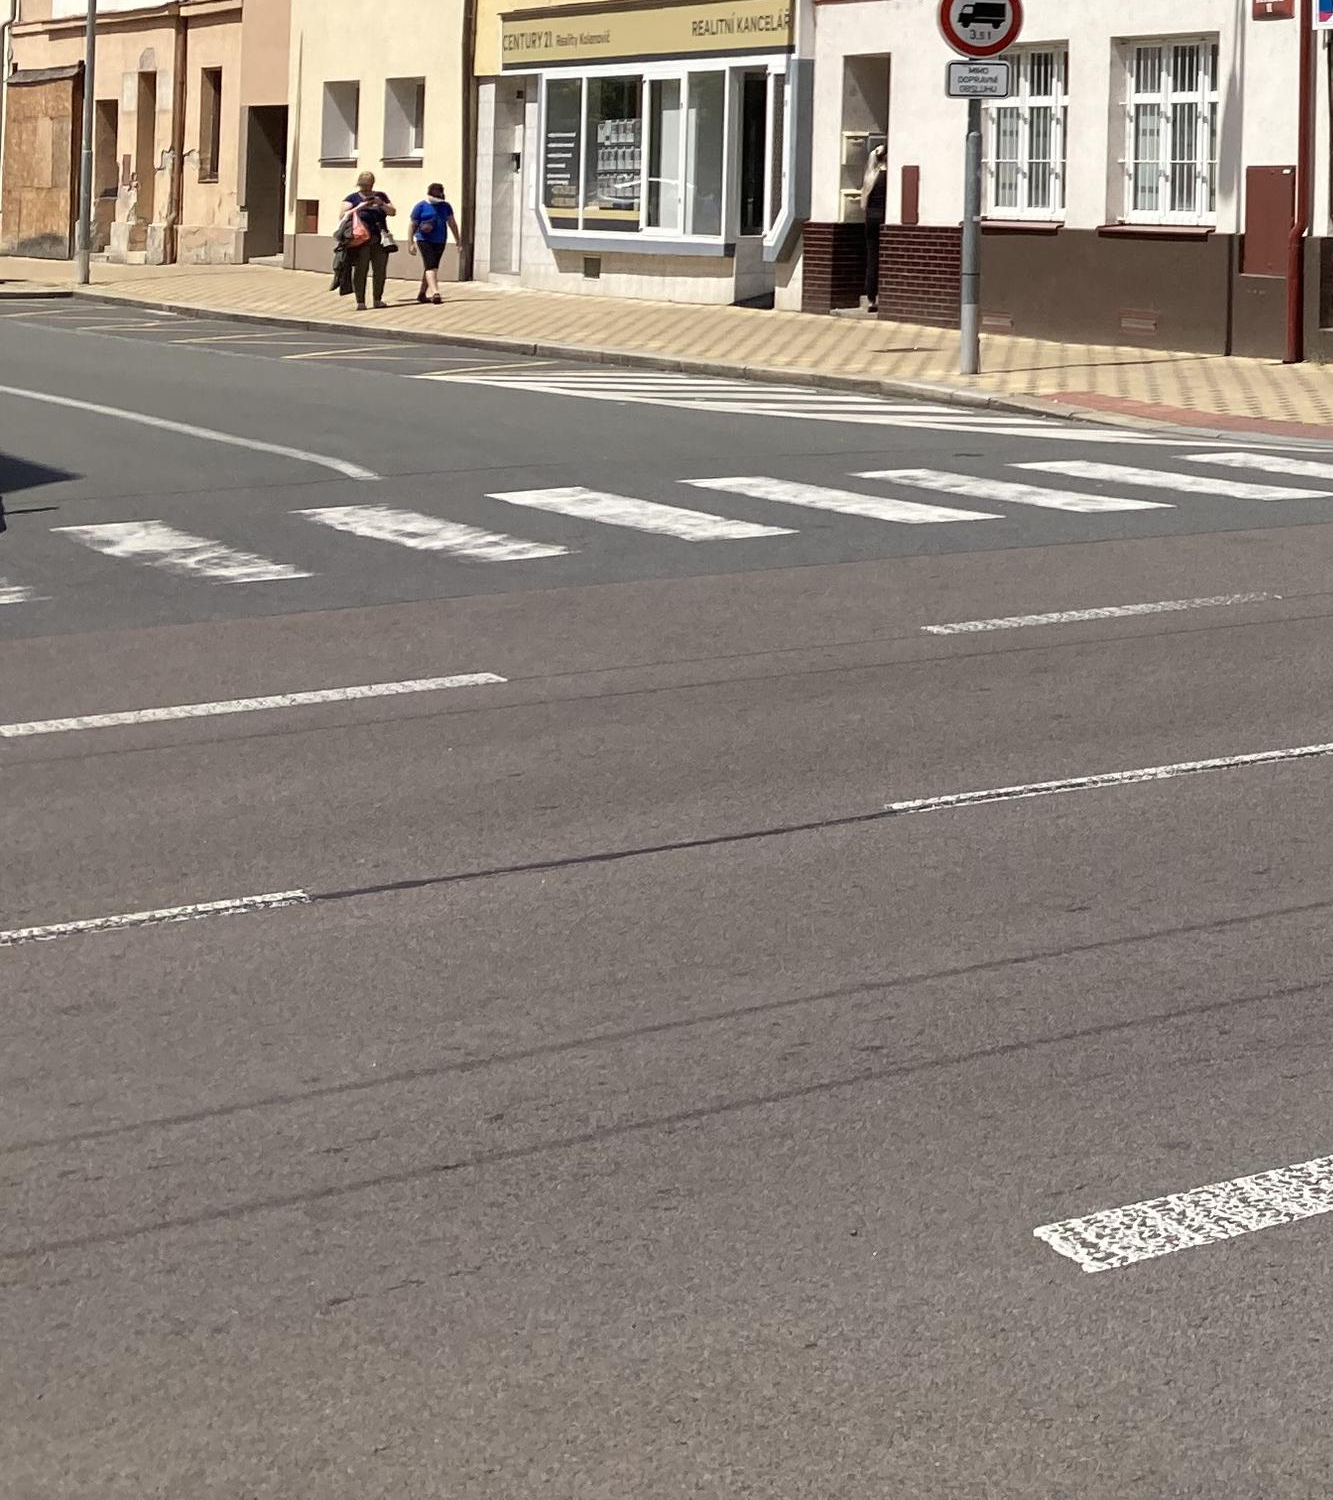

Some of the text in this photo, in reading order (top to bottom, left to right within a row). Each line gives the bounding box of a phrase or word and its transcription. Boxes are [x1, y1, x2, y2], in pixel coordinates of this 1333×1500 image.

[692, 8, 790, 36] REALITNÍ KANCELÁŘ
[503, 31, 542, 51] CENTURY
